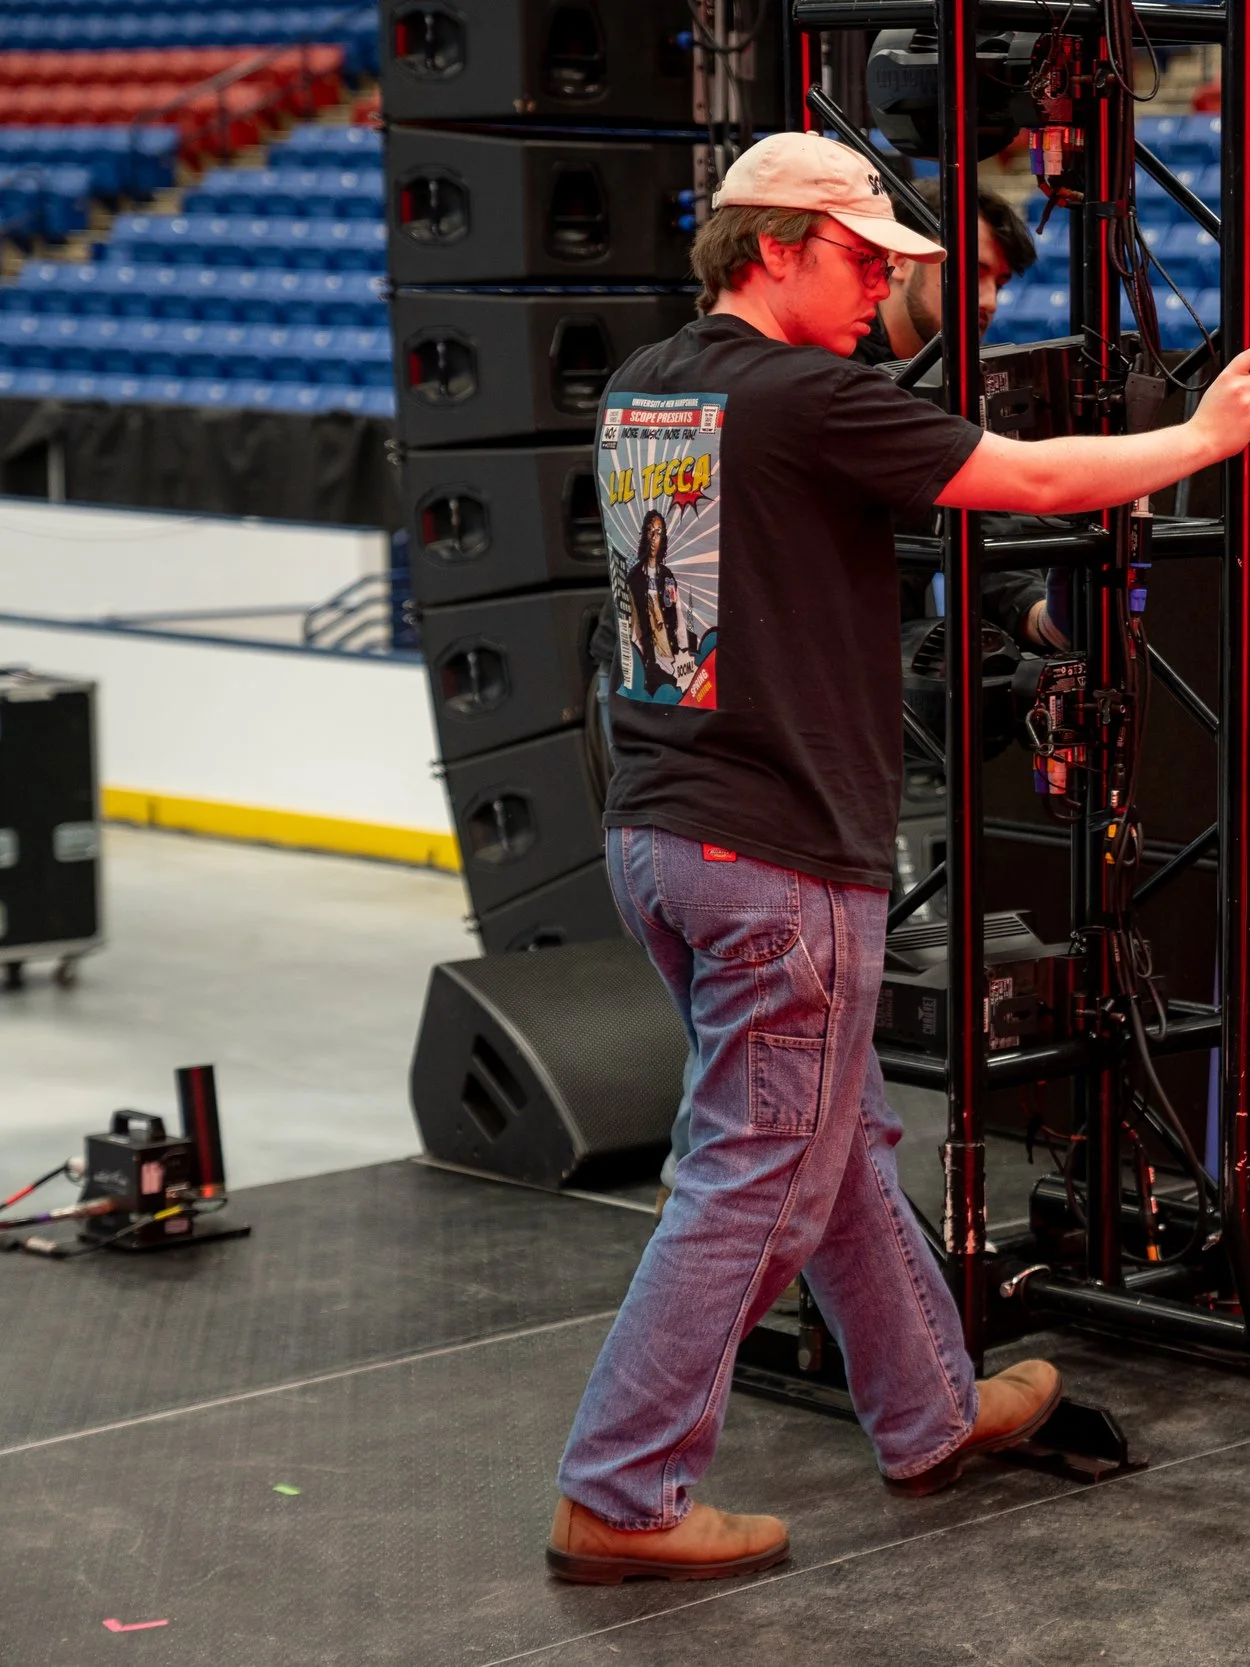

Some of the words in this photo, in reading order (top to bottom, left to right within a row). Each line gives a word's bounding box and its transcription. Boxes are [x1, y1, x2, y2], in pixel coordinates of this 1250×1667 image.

[632, 398, 661, 407] UNIVERSITY
[630, 411, 657, 423] SCOPE
[656, 411, 693, 423] PRESENTS
[621, 427, 638, 439] MORE
[640, 428, 662, 441] MUSIC!
[663, 427, 682, 441] MORE
[682, 428, 697, 441] FUN!
[609, 468, 635, 507] LIL
[641, 453, 712, 502] TECCA
[677, 660, 694, 678] BOOM!
[690, 668, 709, 698] SPRING
